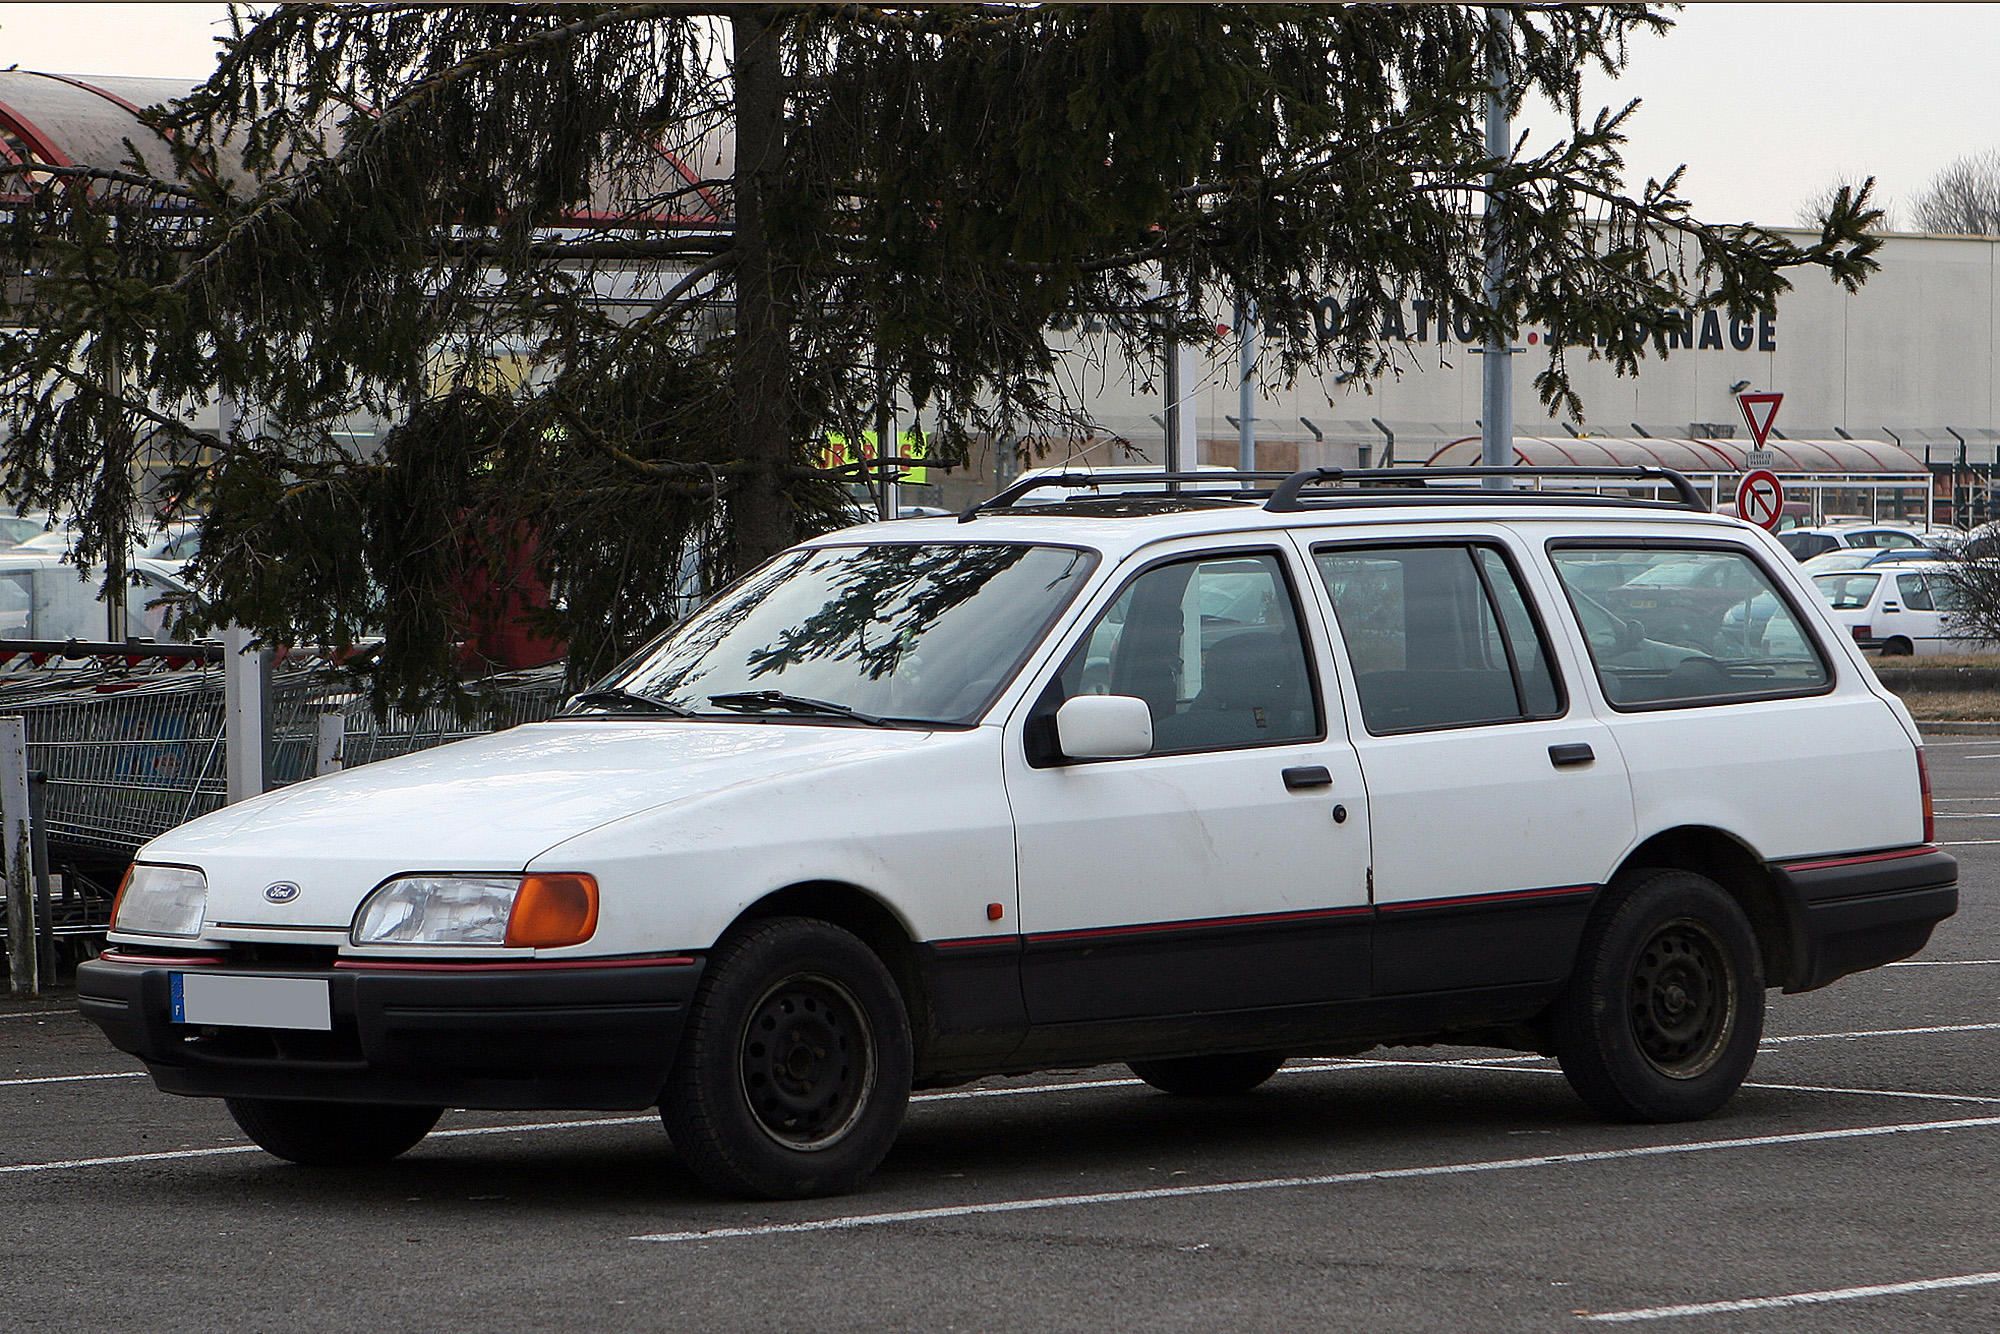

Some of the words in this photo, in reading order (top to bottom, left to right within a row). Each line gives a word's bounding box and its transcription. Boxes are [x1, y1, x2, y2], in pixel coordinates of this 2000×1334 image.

[1233, 295, 1513, 343] ECOATIO
[1544, 304, 1777, 352] JDNAGE
[270, 885, 292, 898] Ford
